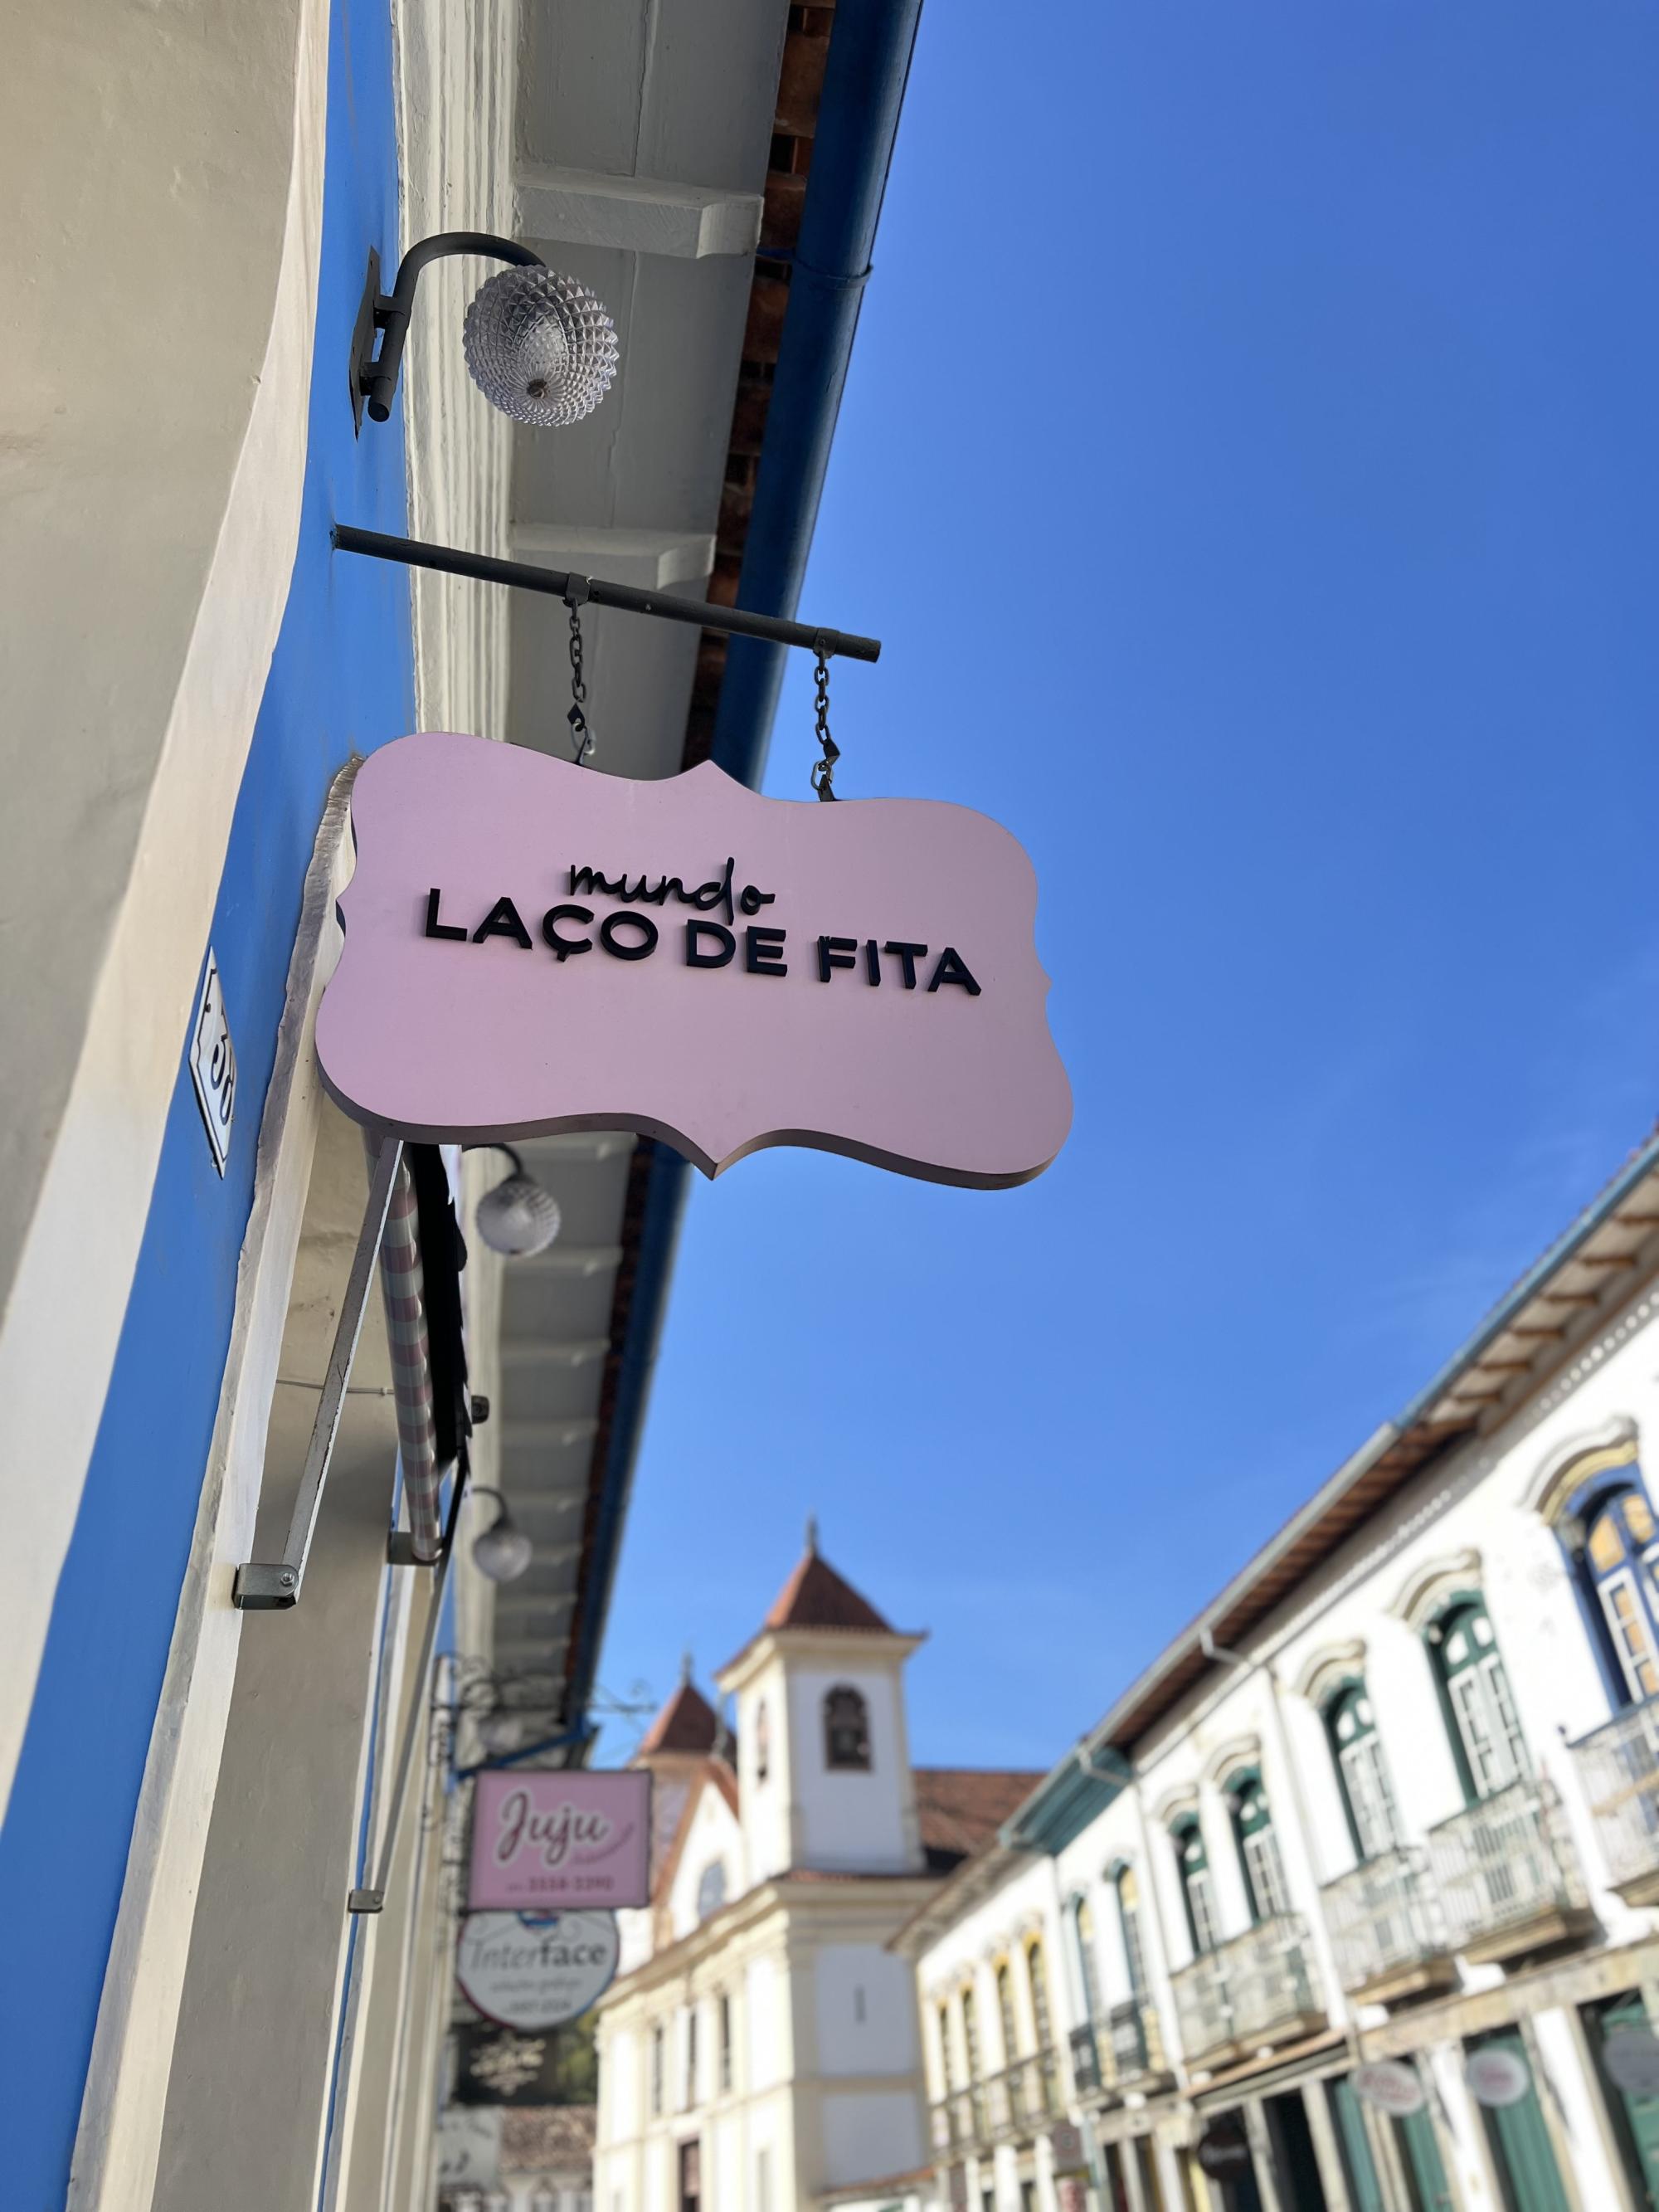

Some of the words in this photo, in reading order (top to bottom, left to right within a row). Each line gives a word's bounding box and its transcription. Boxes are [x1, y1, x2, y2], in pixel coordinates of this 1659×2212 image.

[568, 857, 776, 925] mundo
[424, 888, 659, 962] LAÇO
[684, 918, 788, 977] DE
[818, 935, 981, 996] FITA
[498, 1791, 609, 1866] Juju
[469, 1934, 607, 1971] Interface
